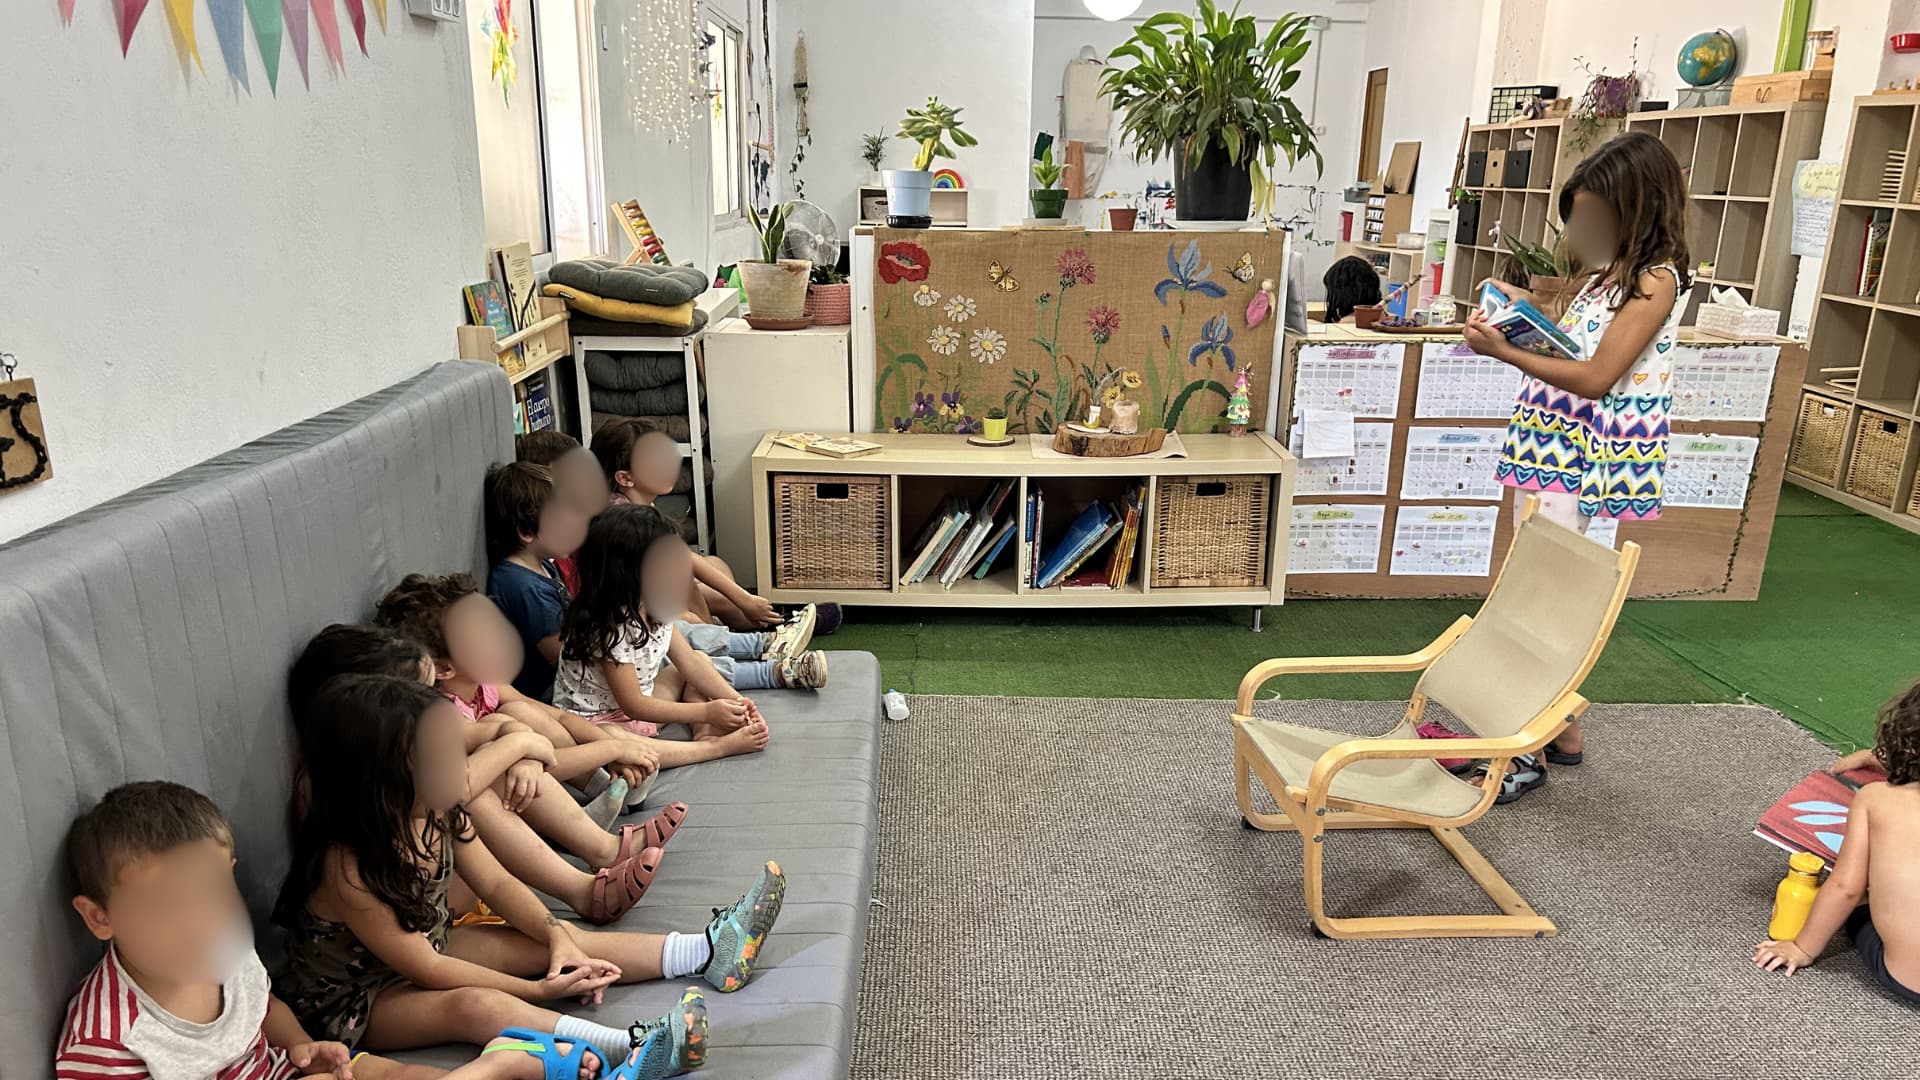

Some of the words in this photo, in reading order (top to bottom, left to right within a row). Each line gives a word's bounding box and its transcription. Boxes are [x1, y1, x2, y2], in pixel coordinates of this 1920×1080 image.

[526, 398, 533, 417] El
[533, 397, 550, 415] cuerpo
[530, 414, 551, 433] humano
